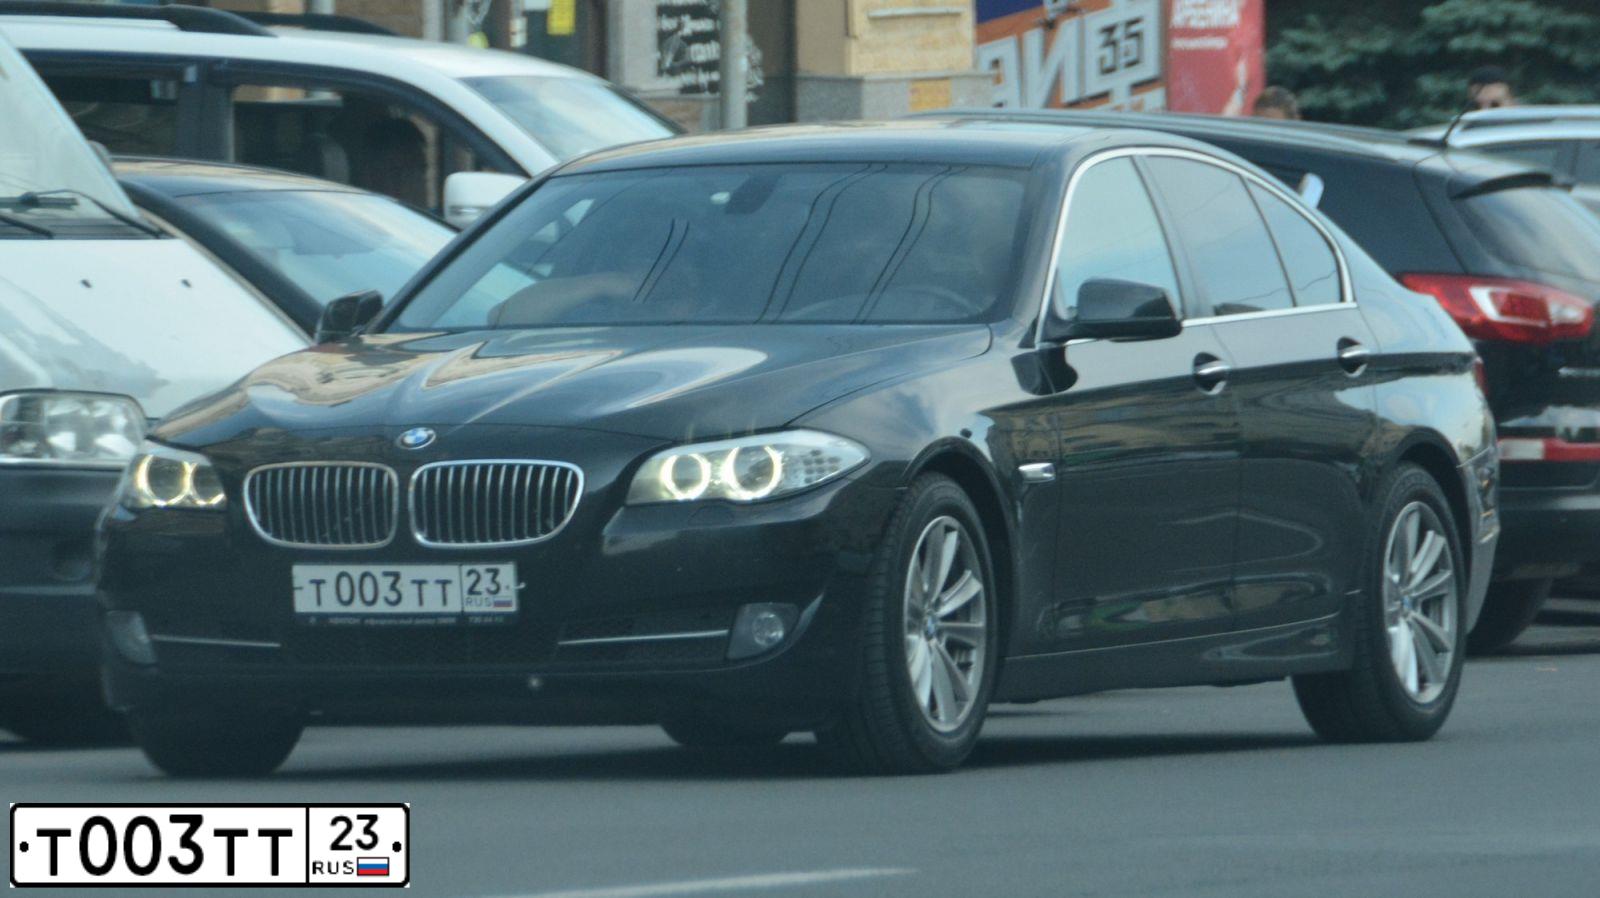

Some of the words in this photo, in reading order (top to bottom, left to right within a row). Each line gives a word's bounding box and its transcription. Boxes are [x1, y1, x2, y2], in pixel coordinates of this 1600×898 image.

[1099, 17, 1144, 76] 35
[308, 570, 453, 607] T003TT
[466, 567, 501, 596] 23
